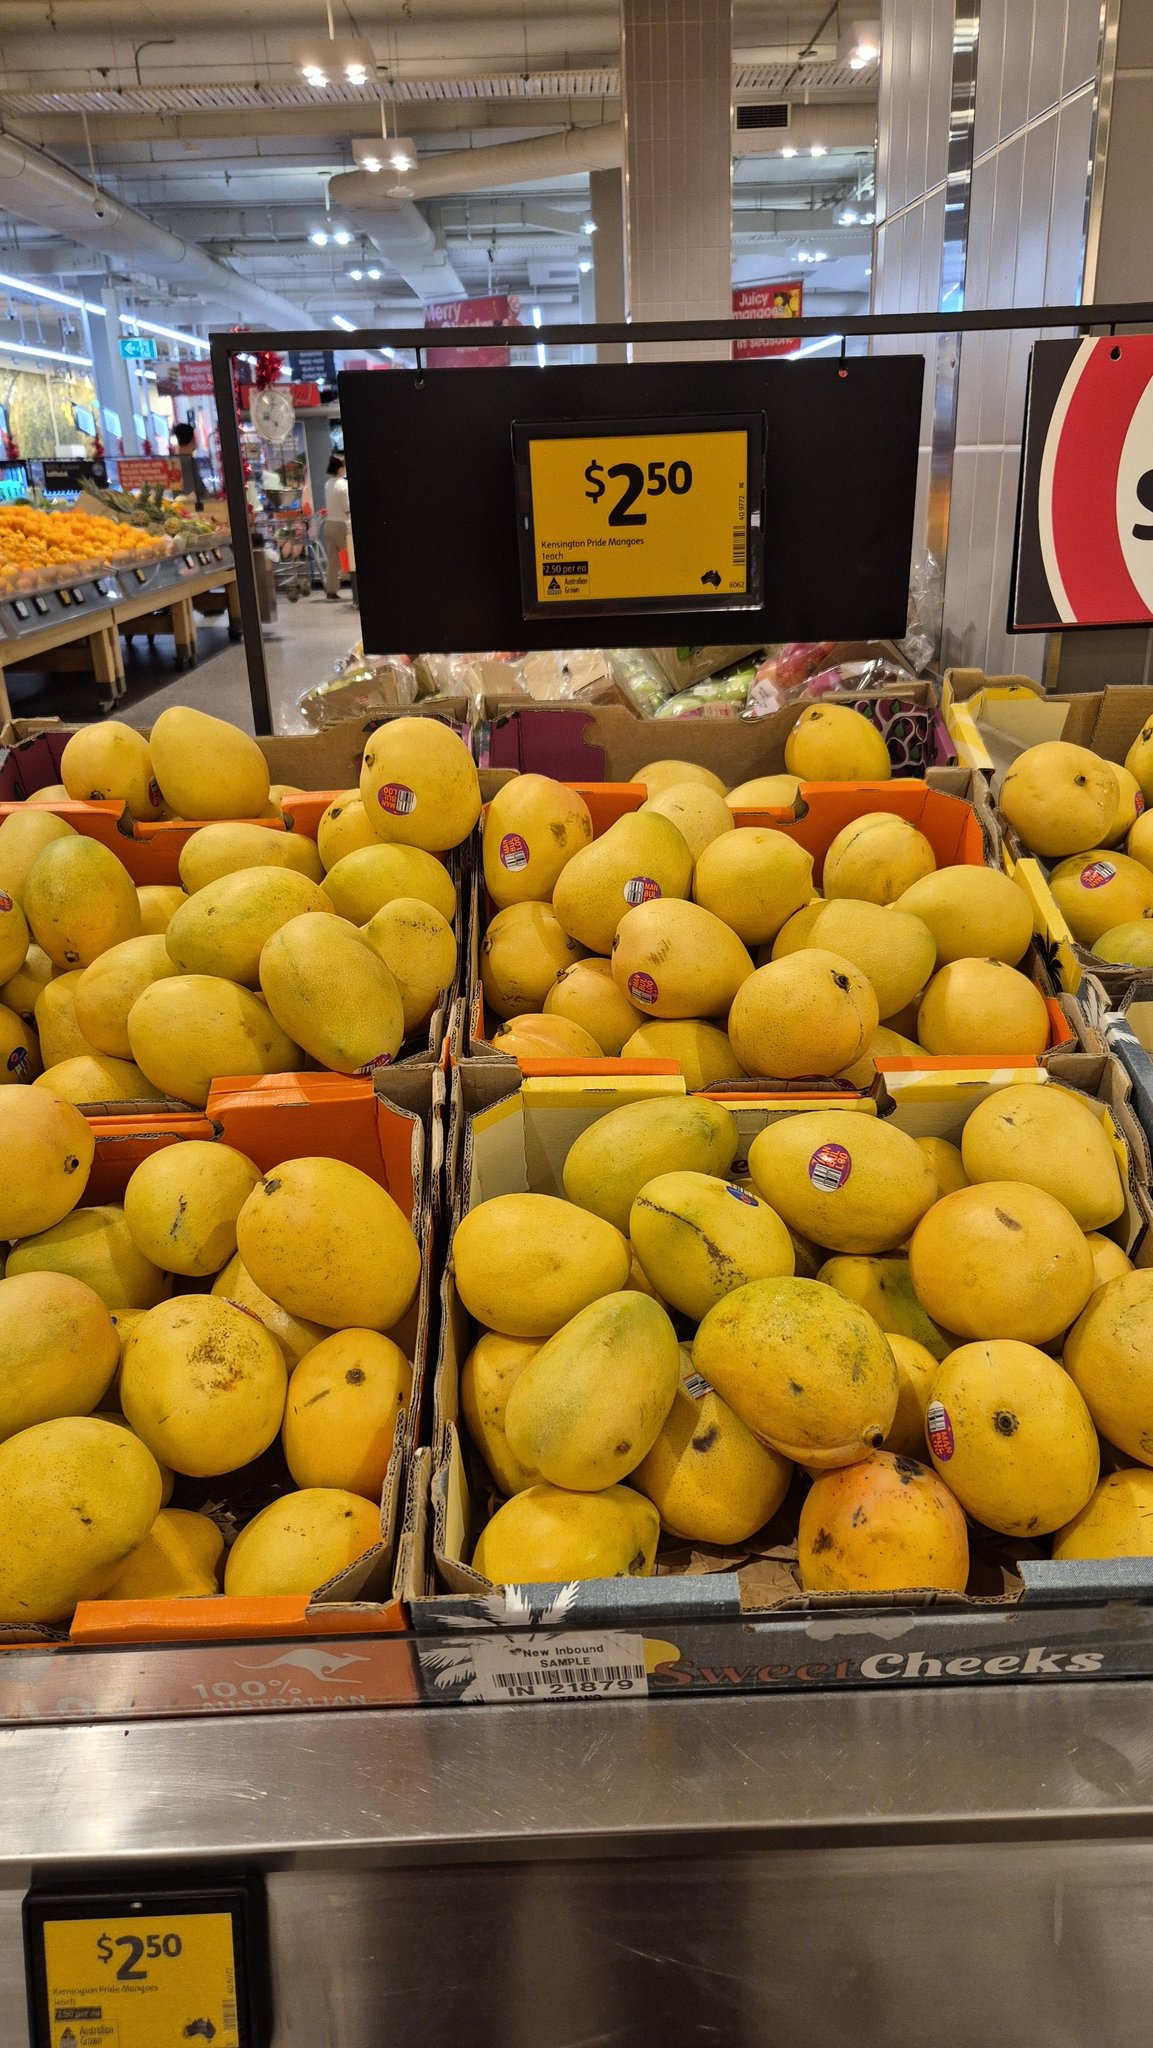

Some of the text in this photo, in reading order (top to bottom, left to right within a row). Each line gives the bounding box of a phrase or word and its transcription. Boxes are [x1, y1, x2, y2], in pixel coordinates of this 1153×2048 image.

[739, 292, 769, 307] Juicy
[425, 303, 461, 322] Merry
[541, 537, 645, 551] Kensington Pride Mangoes
[563, 565, 576, 575] per
[576, 564, 587, 573] ea
[522, 1645, 605, 1658] New Inbound
[540, 1657, 592, 1668] SAMPLE
[653, 1646, 1106, 1688] Sweet Cheeks
[192, 1679, 302, 1699] 100%
[507, 1679, 634, 1697] IN 21879
